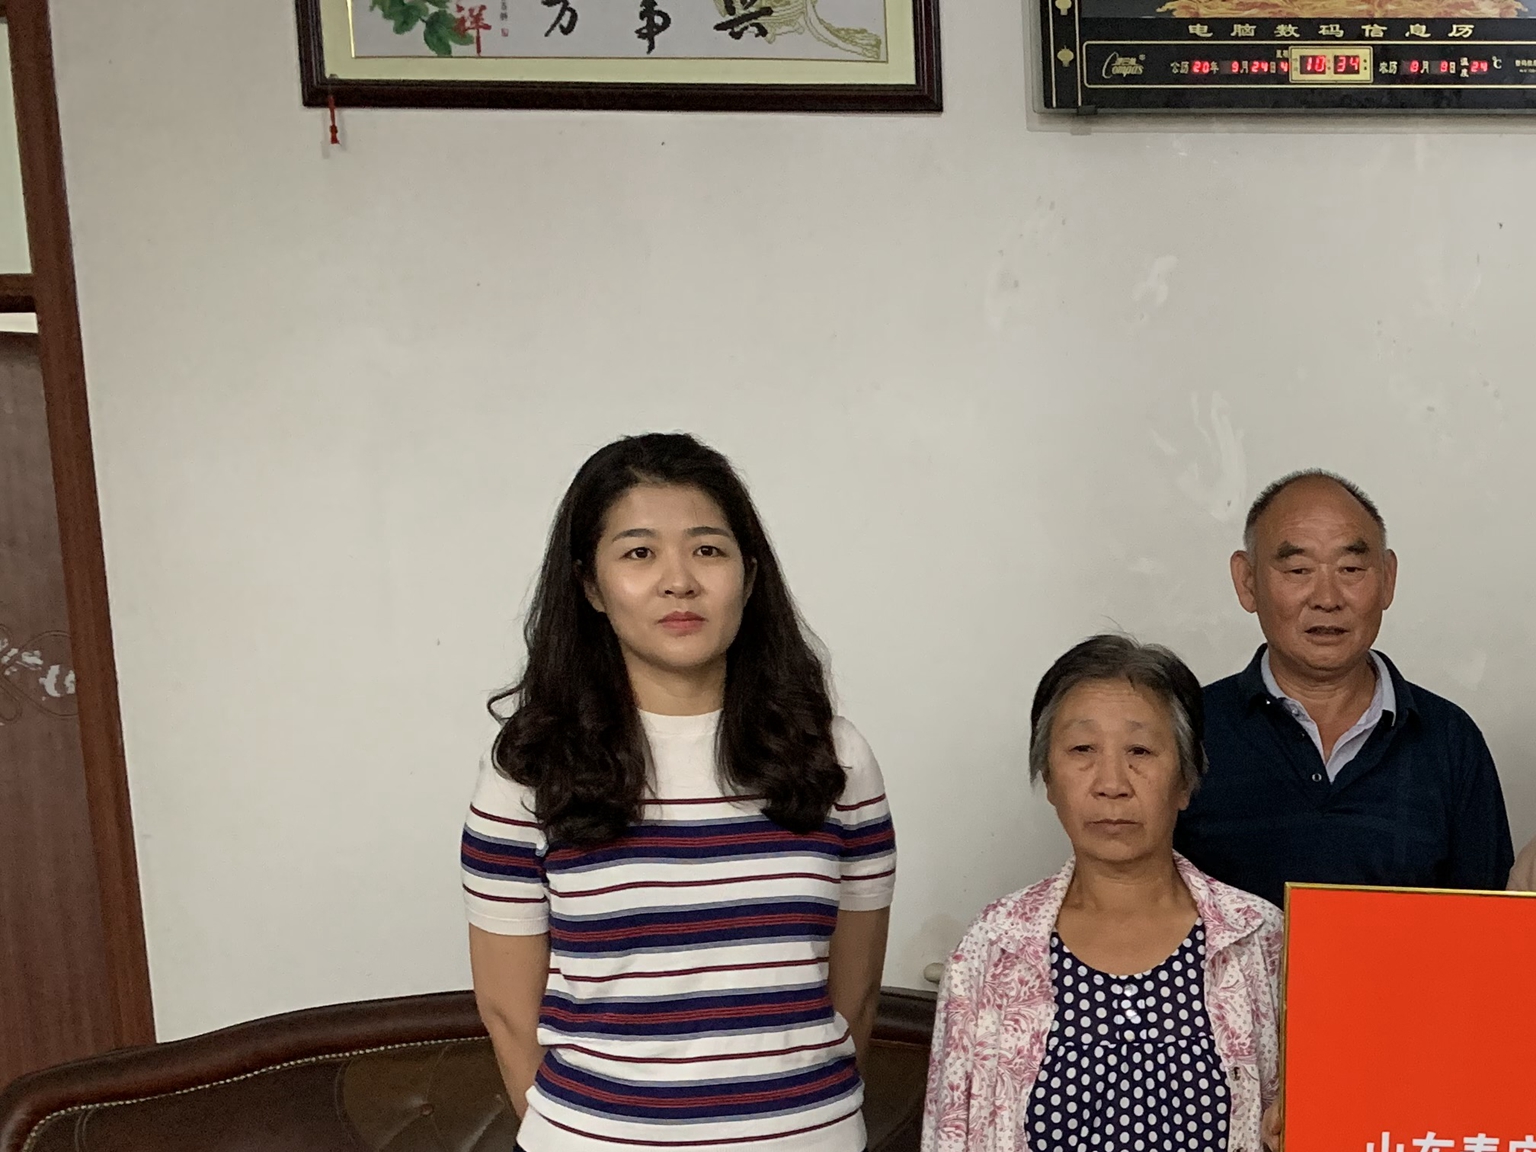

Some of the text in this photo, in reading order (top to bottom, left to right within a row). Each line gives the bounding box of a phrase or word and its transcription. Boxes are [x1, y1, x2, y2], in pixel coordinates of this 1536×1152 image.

[1188, 23, 1475, 38] 电脑数码信息历
